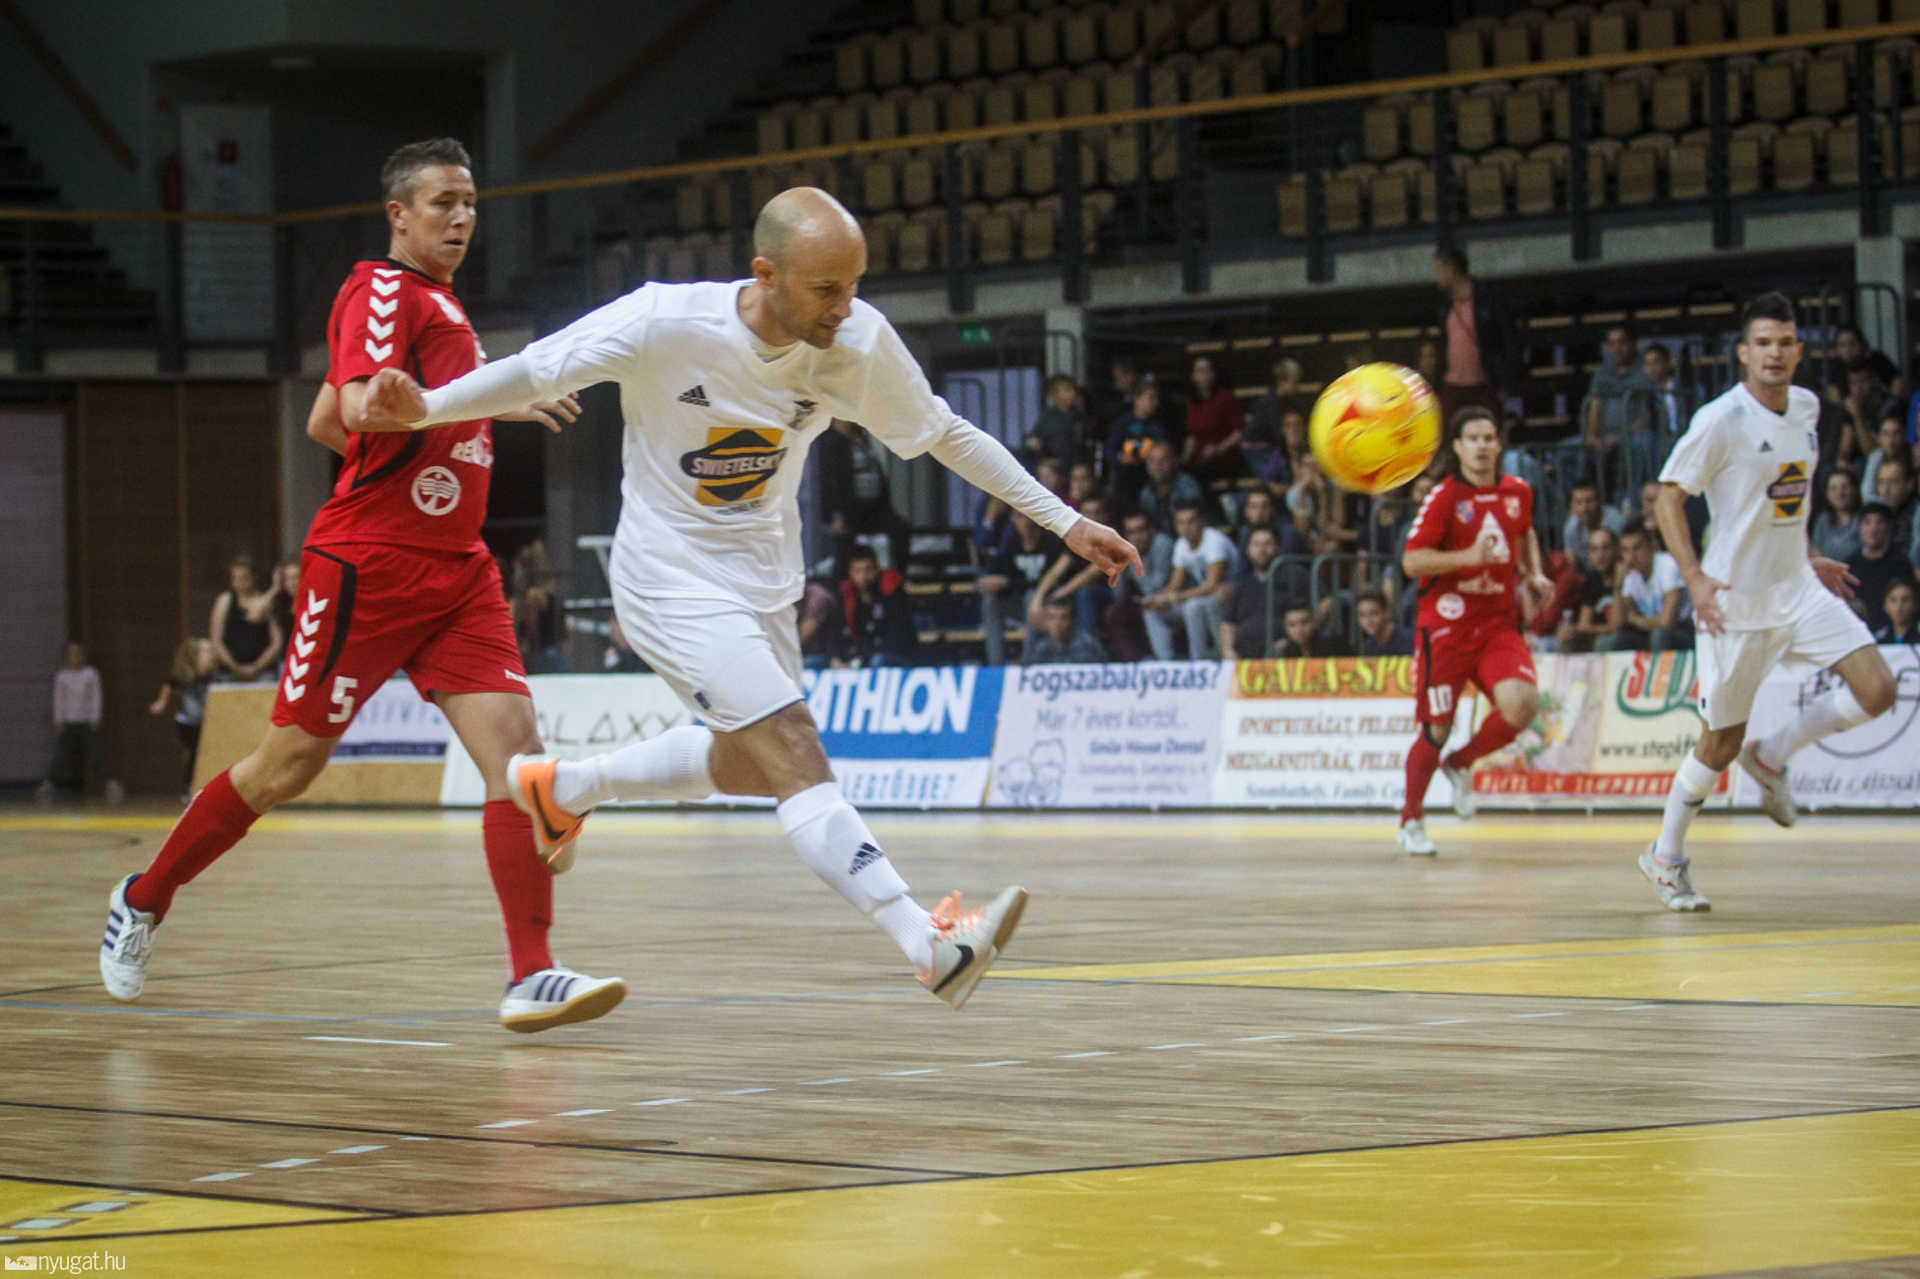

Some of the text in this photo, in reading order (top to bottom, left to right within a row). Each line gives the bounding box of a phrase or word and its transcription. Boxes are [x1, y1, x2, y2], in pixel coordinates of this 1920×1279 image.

[1239, 656, 1415, 695] GALA-SPO
[328, 676, 358, 723] 5
[801, 666, 978, 734] ATHLON
[1428, 684, 1452, 716] 10
[536, 711, 682, 745] ALAXY
